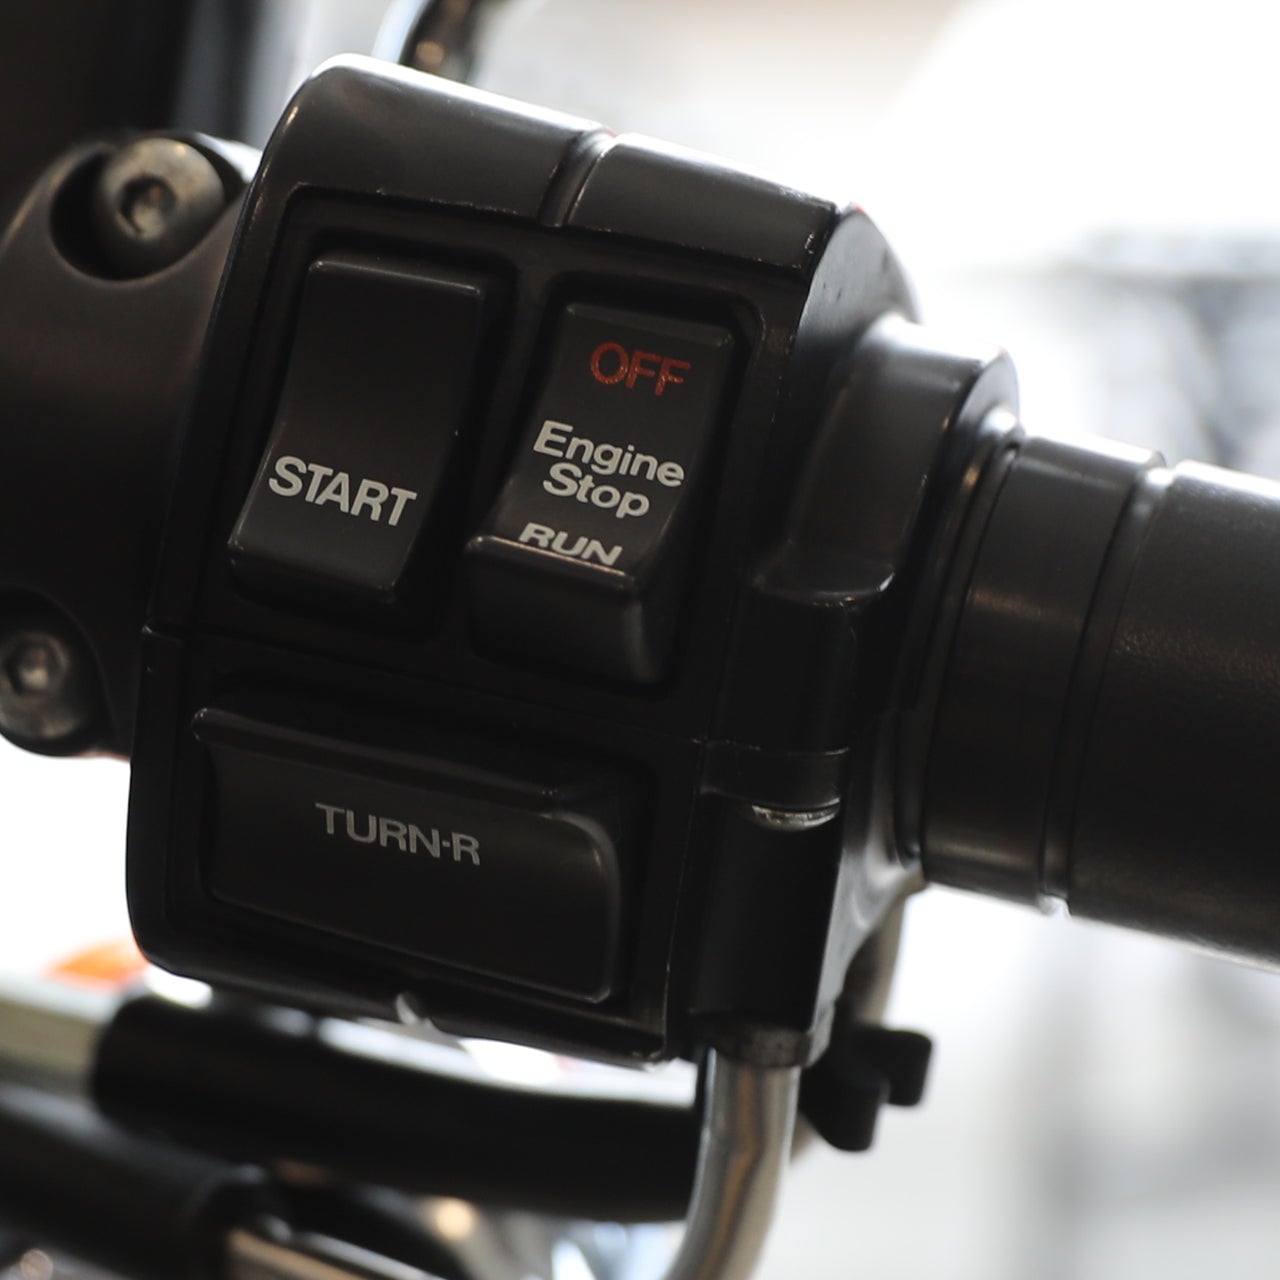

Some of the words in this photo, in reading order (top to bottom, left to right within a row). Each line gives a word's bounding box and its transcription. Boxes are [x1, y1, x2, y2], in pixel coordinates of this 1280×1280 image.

[590, 342, 691, 395] OFF
[533, 420, 686, 488] Engine
[268, 455, 417, 526] START
[543, 463, 650, 519] Stop
[518, 522, 623, 566] RUN
